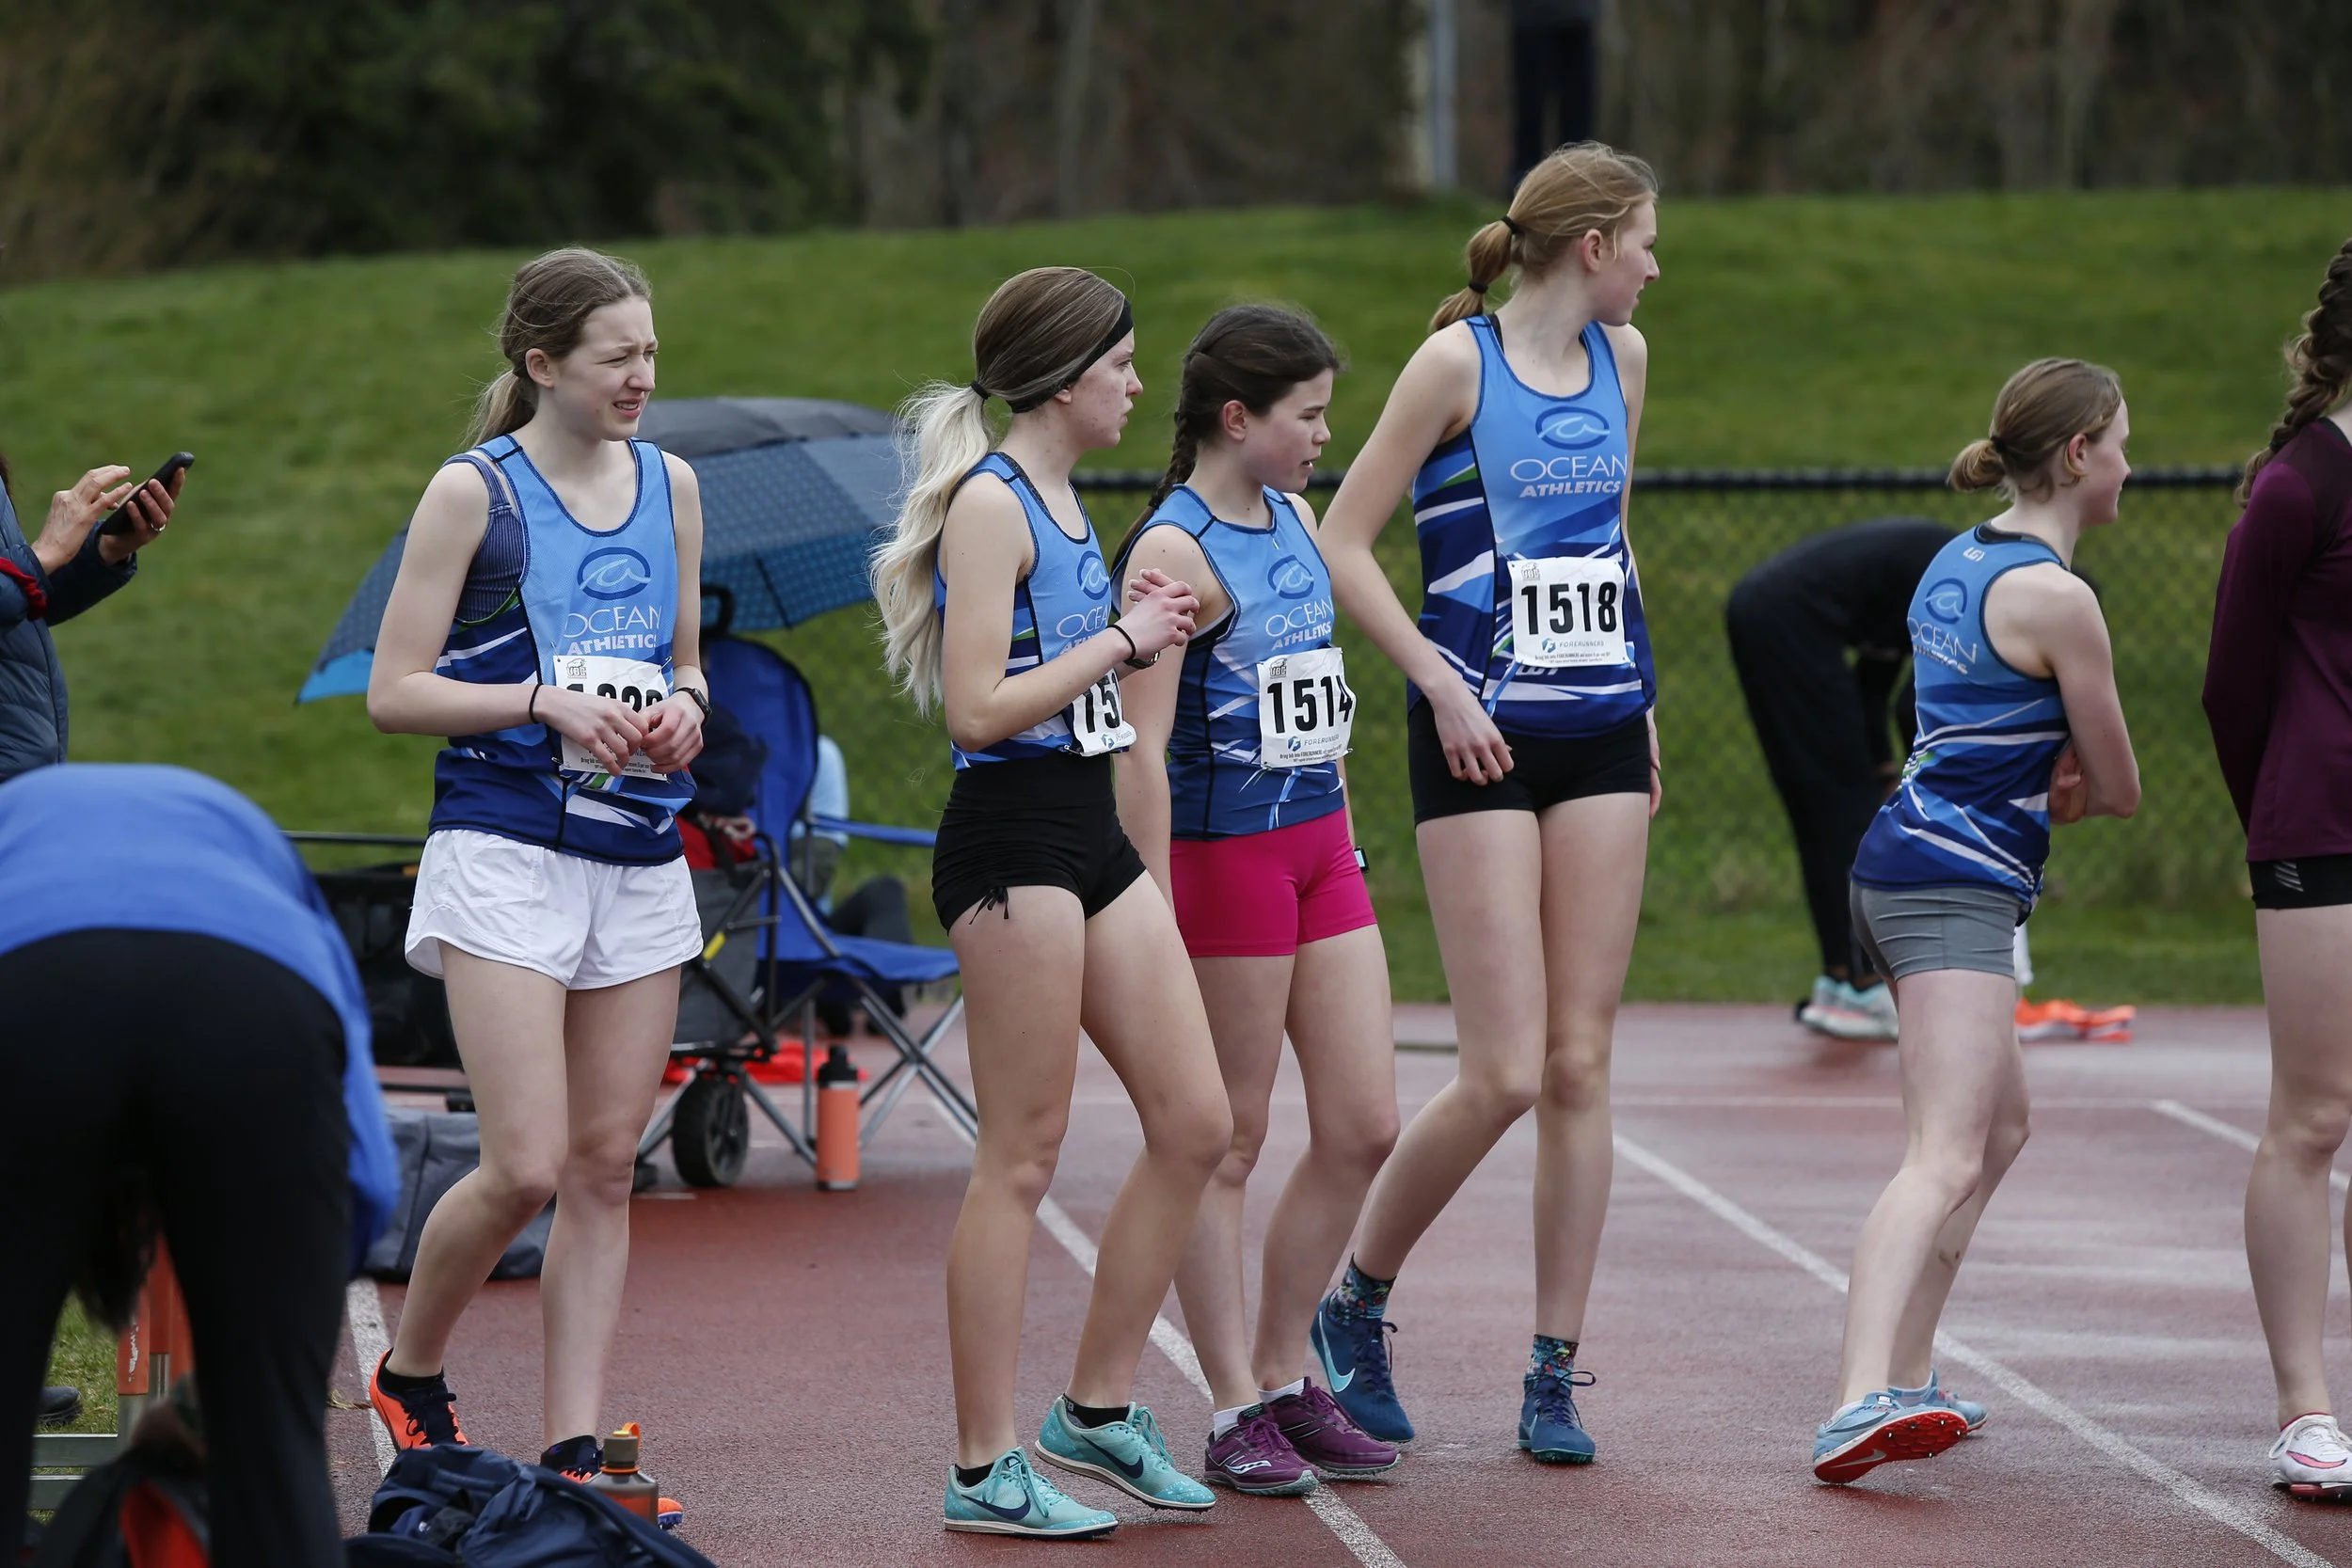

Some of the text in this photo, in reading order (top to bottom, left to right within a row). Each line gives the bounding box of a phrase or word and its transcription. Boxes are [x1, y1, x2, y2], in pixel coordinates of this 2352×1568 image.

[1510, 453, 1628, 483] OCEAN
[1519, 480, 1622, 499] ATHLETICS
[564, 605, 662, 639] OCEAN
[1265, 594, 1334, 638] OCEAN
[1520, 581, 1618, 636] 1518
[566, 631, 658, 657] ATHLETIC
[1271, 620, 1332, 652] ATHLETICS
[1906, 617, 1978, 665] OCEAN
[566, 666, 587, 677] UBC
[1266, 674, 1354, 735] 1514
